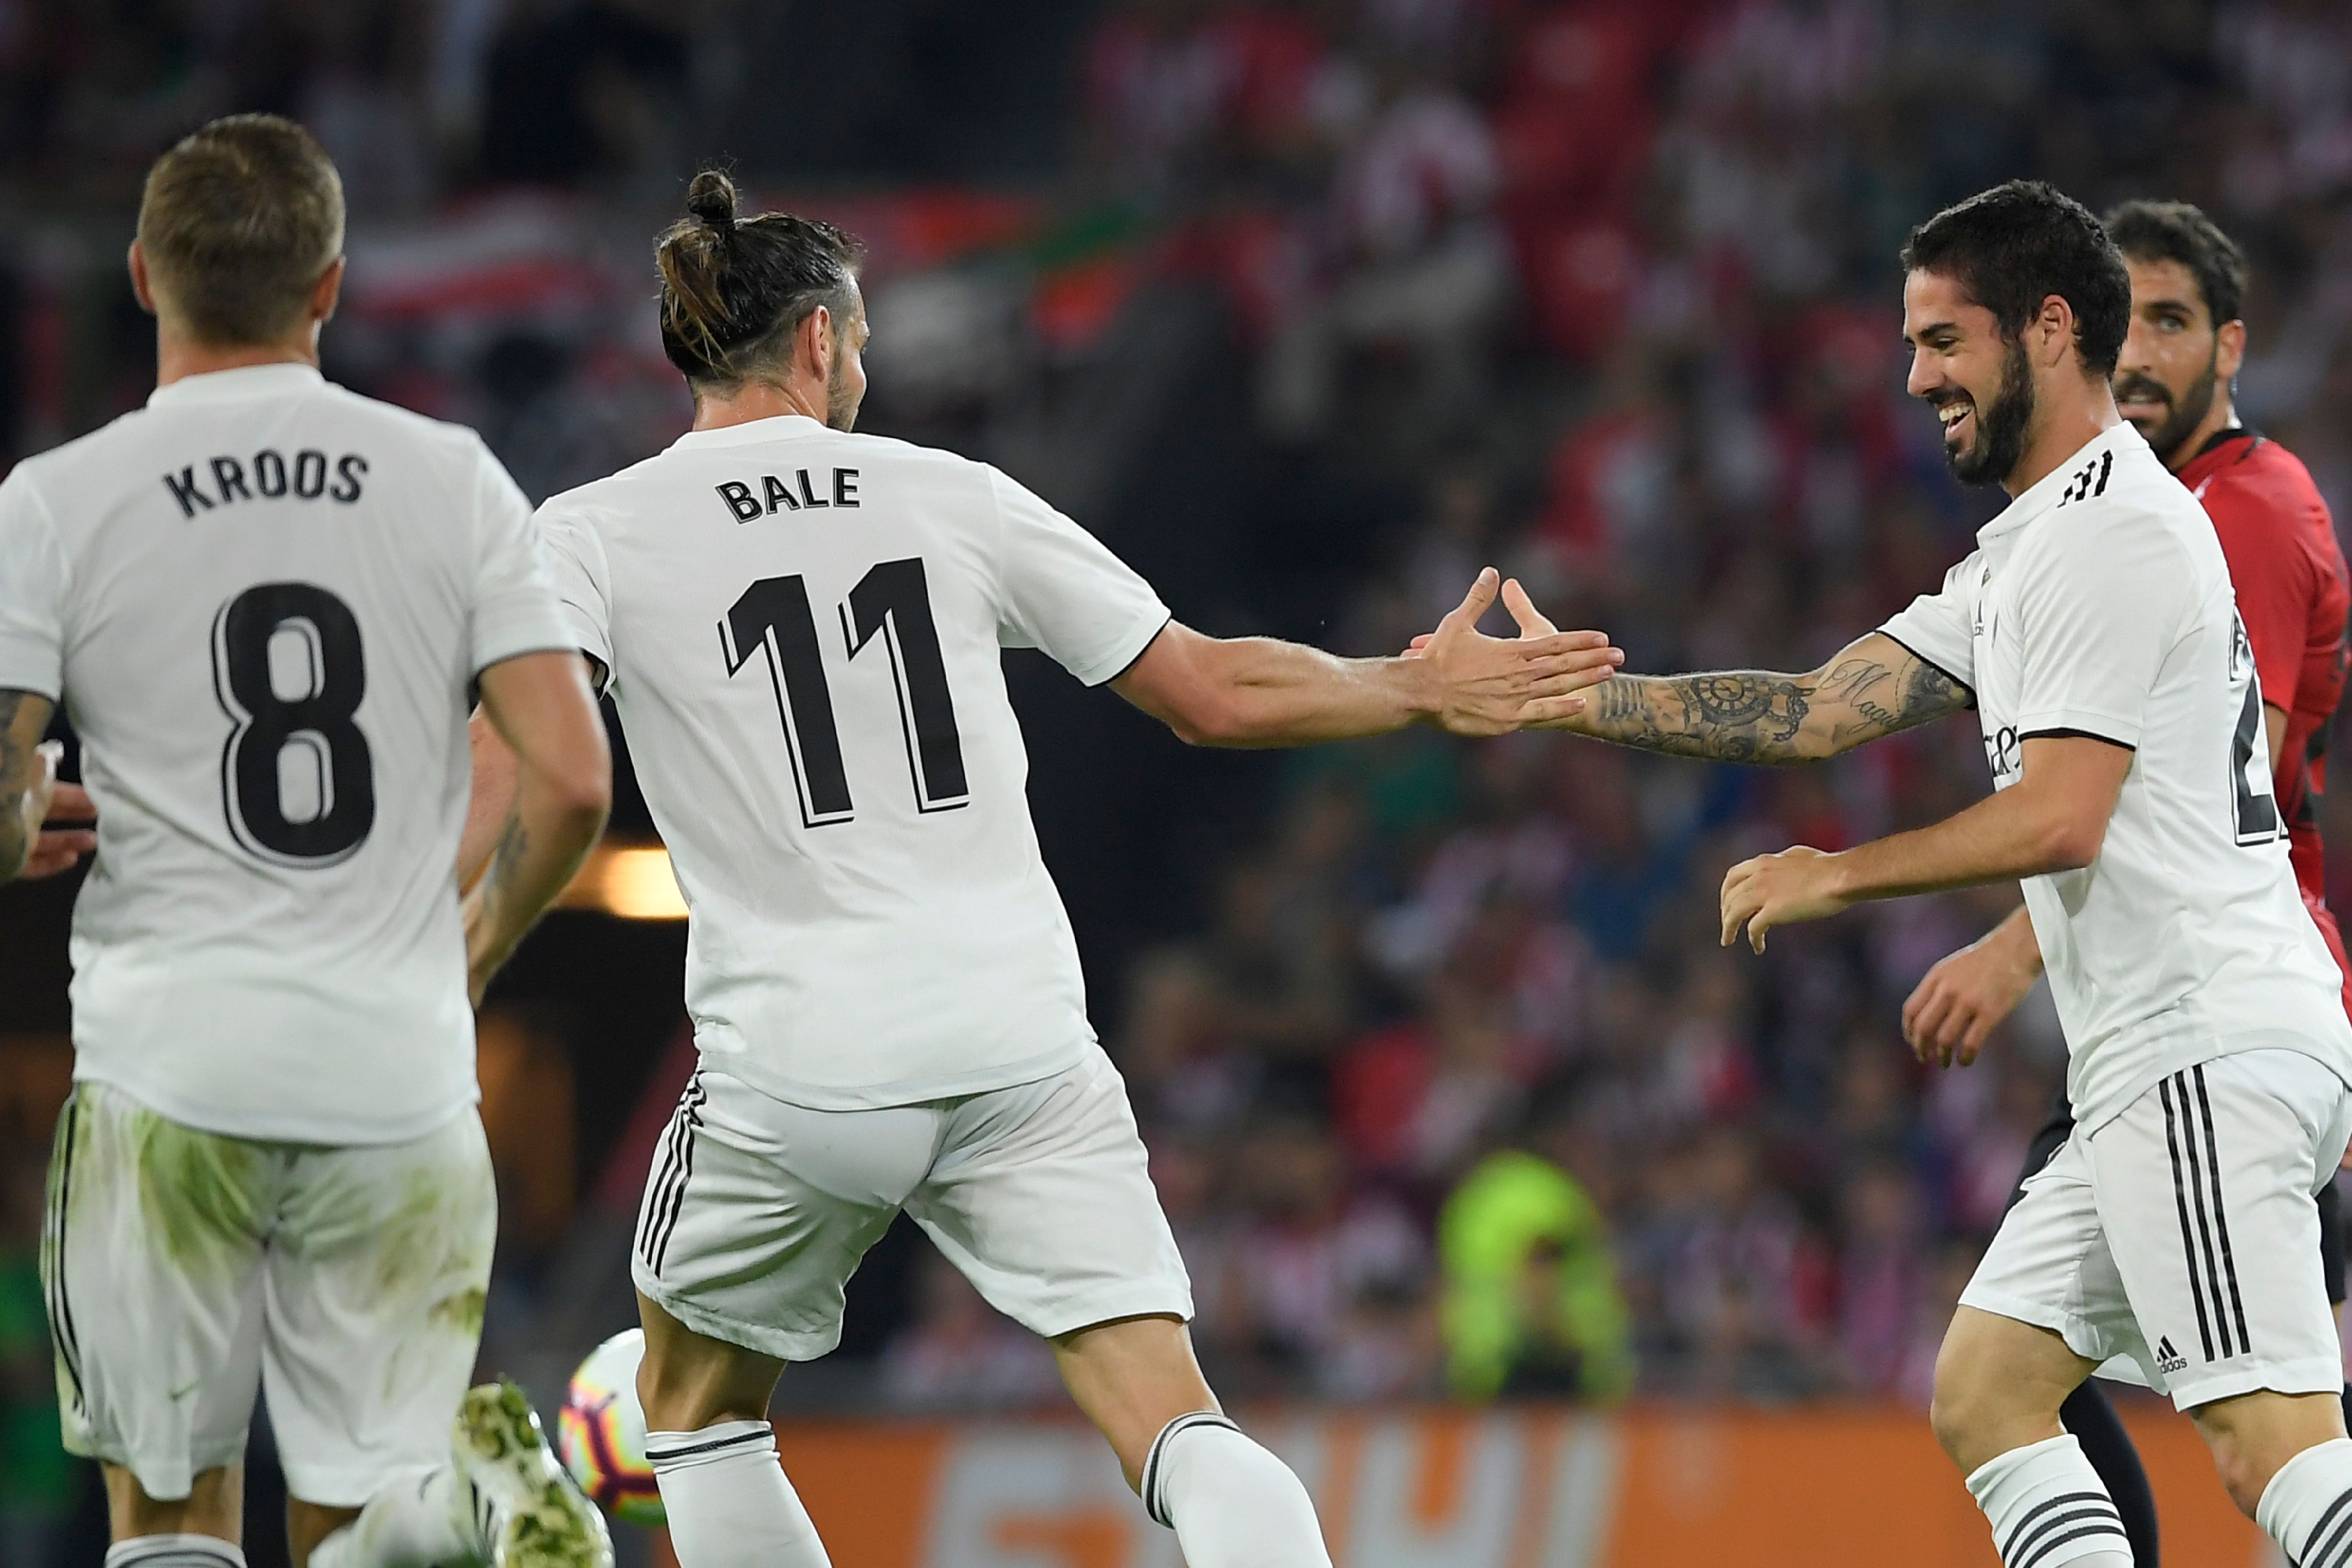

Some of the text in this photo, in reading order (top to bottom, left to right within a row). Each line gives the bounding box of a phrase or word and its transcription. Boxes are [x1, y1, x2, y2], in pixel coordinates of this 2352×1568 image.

[163, 449, 369, 519] KROOS
[715, 467, 860, 524] BALE
[212, 581, 377, 870] 8
[717, 557, 970, 829] 11
[2229, 607, 2289, 848] 2
